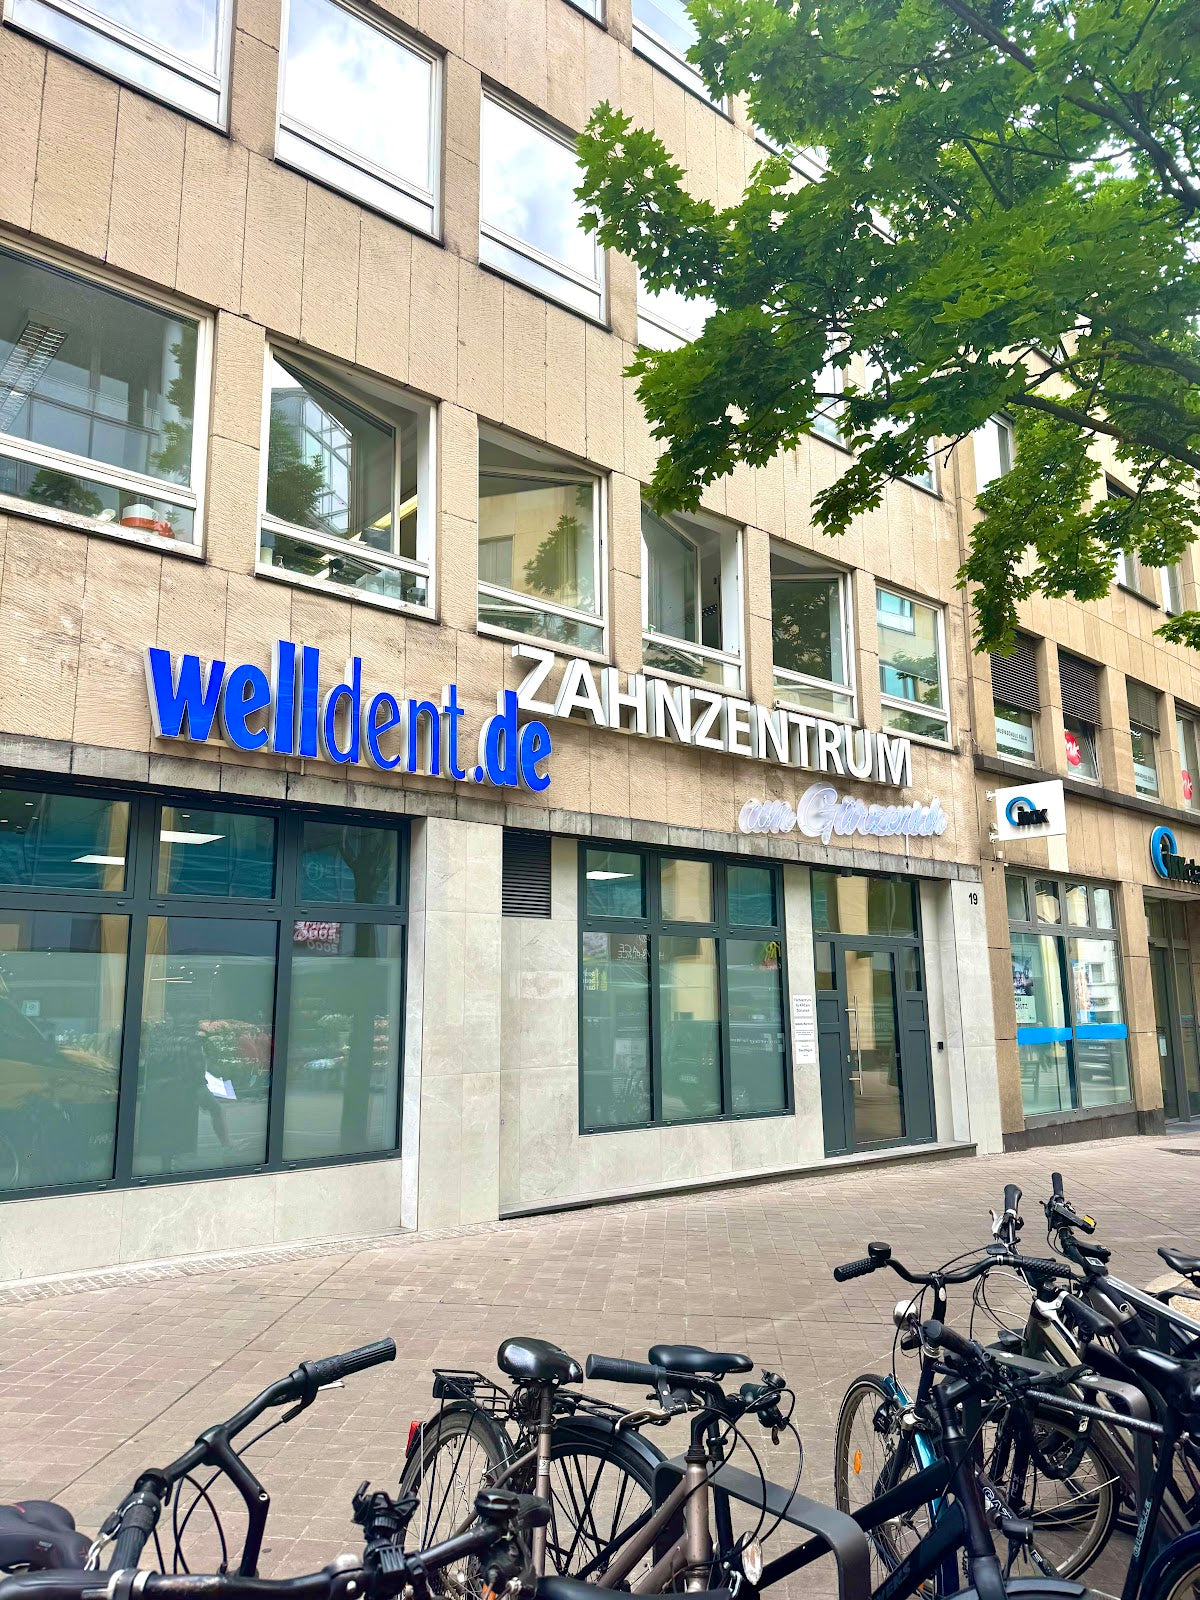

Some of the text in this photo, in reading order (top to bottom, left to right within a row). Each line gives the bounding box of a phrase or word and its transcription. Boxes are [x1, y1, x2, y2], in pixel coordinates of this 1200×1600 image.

[146, 640, 553, 793] welldent.de
[512, 644, 912, 788] ZAHNZENTRUM
[740, 782, 948, 844] am Gürzenich
[968, 892, 978, 905] 19
